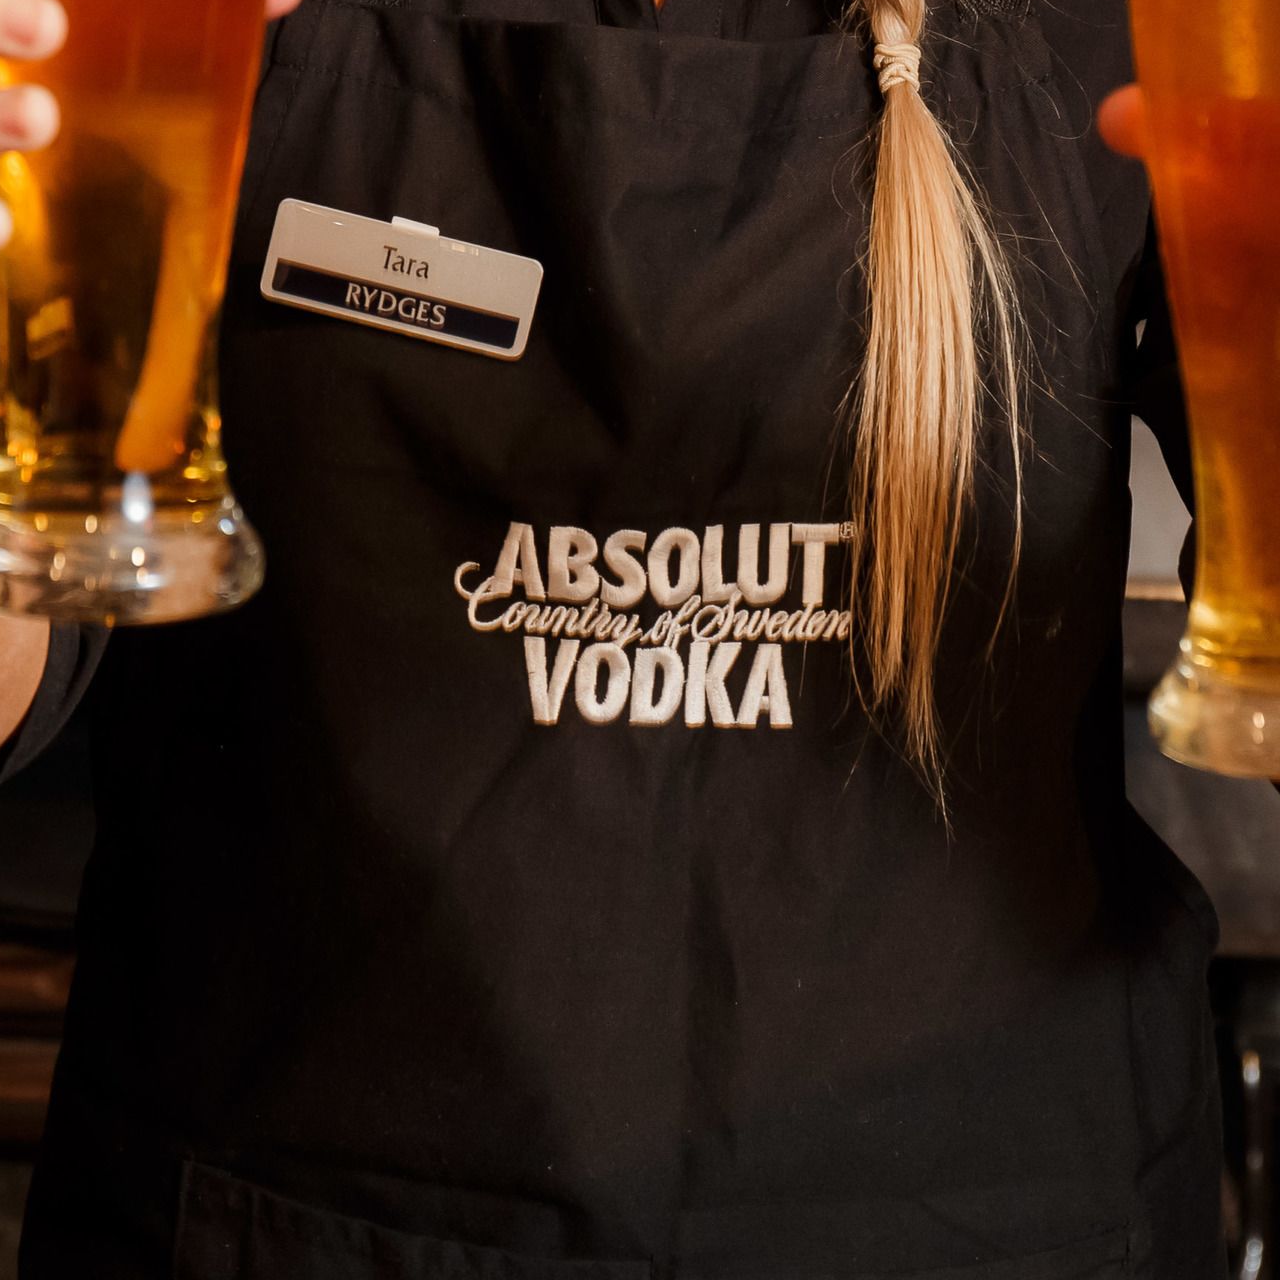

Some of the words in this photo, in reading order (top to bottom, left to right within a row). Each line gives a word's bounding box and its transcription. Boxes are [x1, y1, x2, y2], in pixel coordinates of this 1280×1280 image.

[383, 244, 431, 279] Tara
[345, 282, 447, 326] RYDGES
[454, 561, 643, 648] Country
[640, 594, 703, 648] of
[691, 586, 852, 644] Sweden
[524, 634, 794, 729] VODKA
